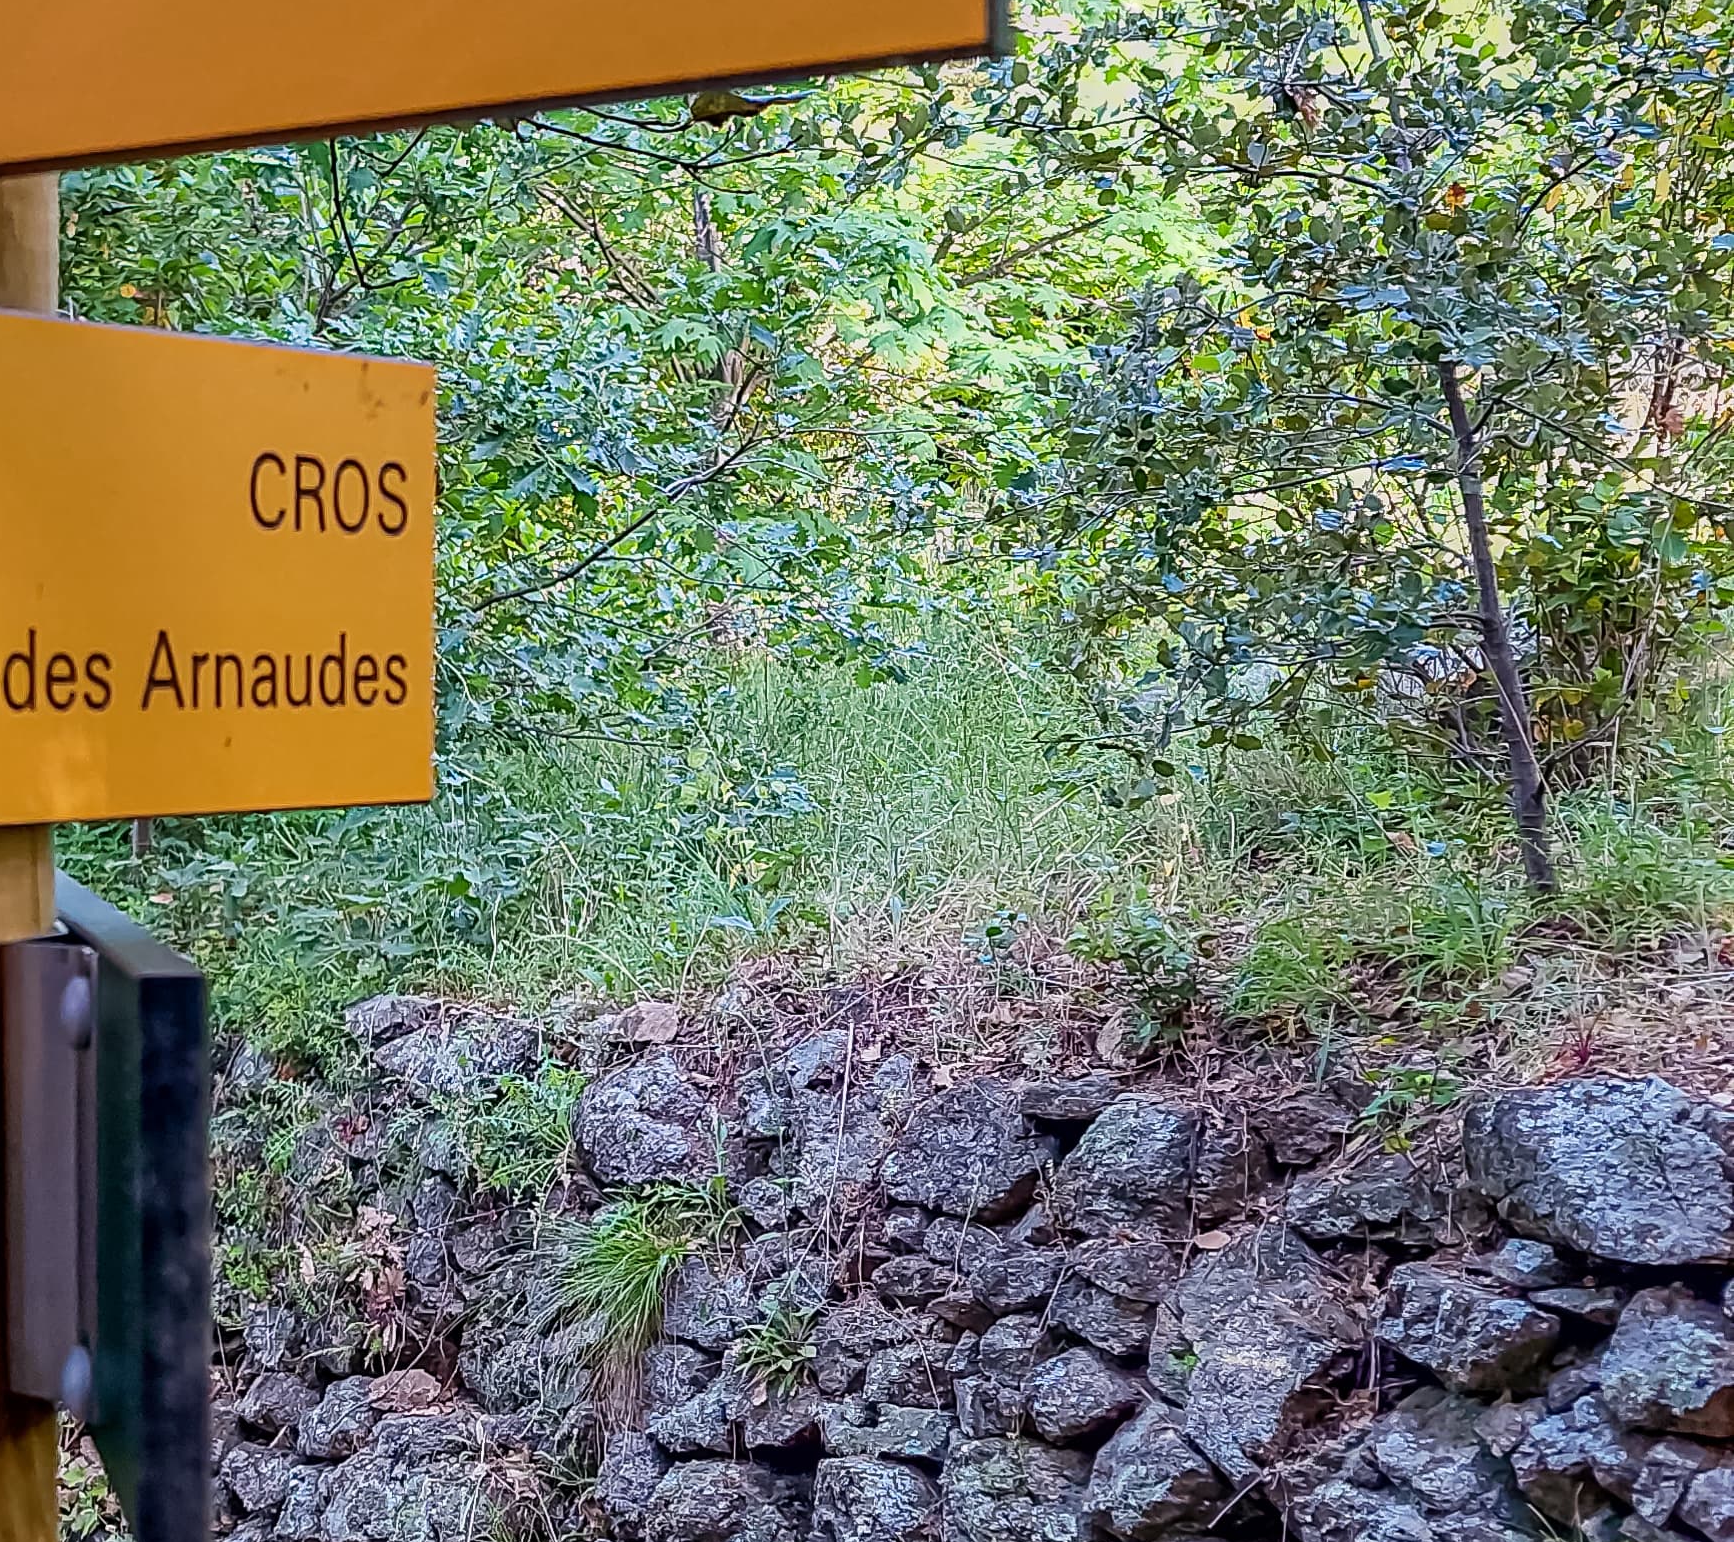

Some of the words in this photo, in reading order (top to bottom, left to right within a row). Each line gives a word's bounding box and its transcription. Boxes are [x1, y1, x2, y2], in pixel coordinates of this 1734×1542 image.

[249, 450, 410, 537] CROS
[1, 627, 113, 713] des
[141, 628, 409, 712] Arnaudes
